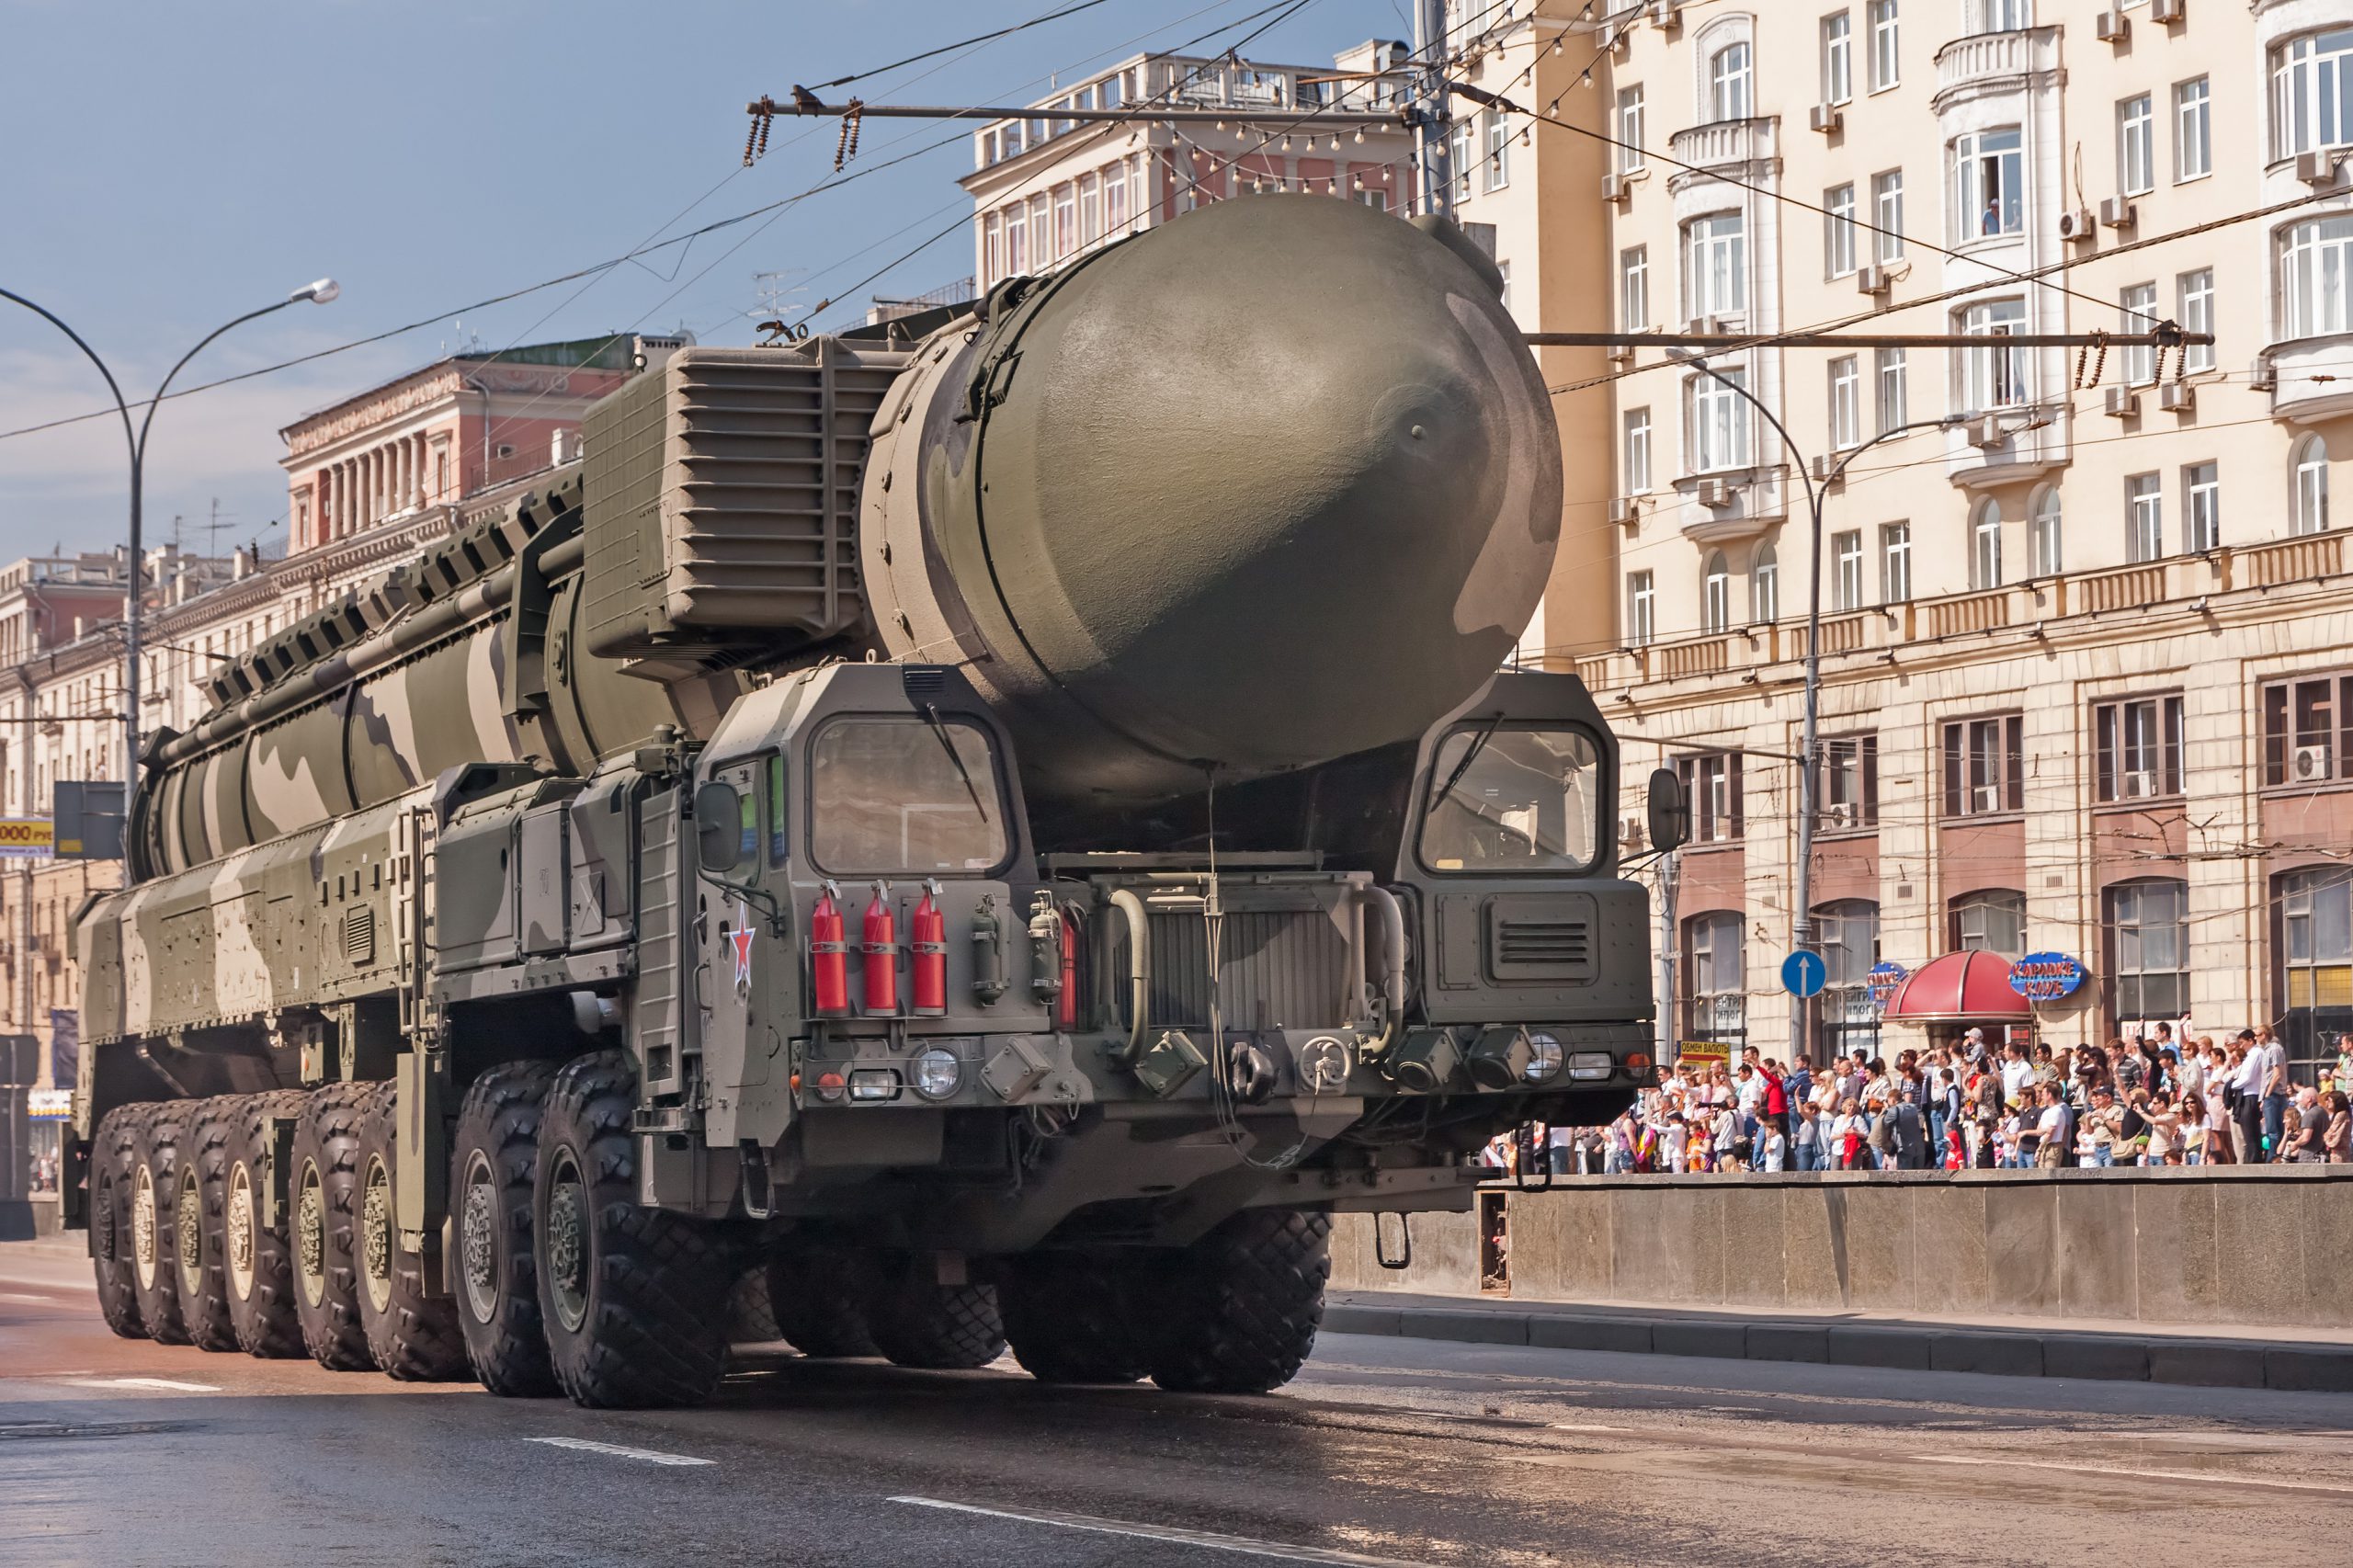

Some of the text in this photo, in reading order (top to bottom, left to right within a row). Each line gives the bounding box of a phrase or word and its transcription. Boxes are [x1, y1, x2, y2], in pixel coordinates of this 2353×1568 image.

[2013, 961, 2075, 977] КАРАОКЕ
[2025, 981, 2063, 995] КЛУБ
[1682, 1042, 1730, 1054] ОБМЕН ВАЛЮТЫ
